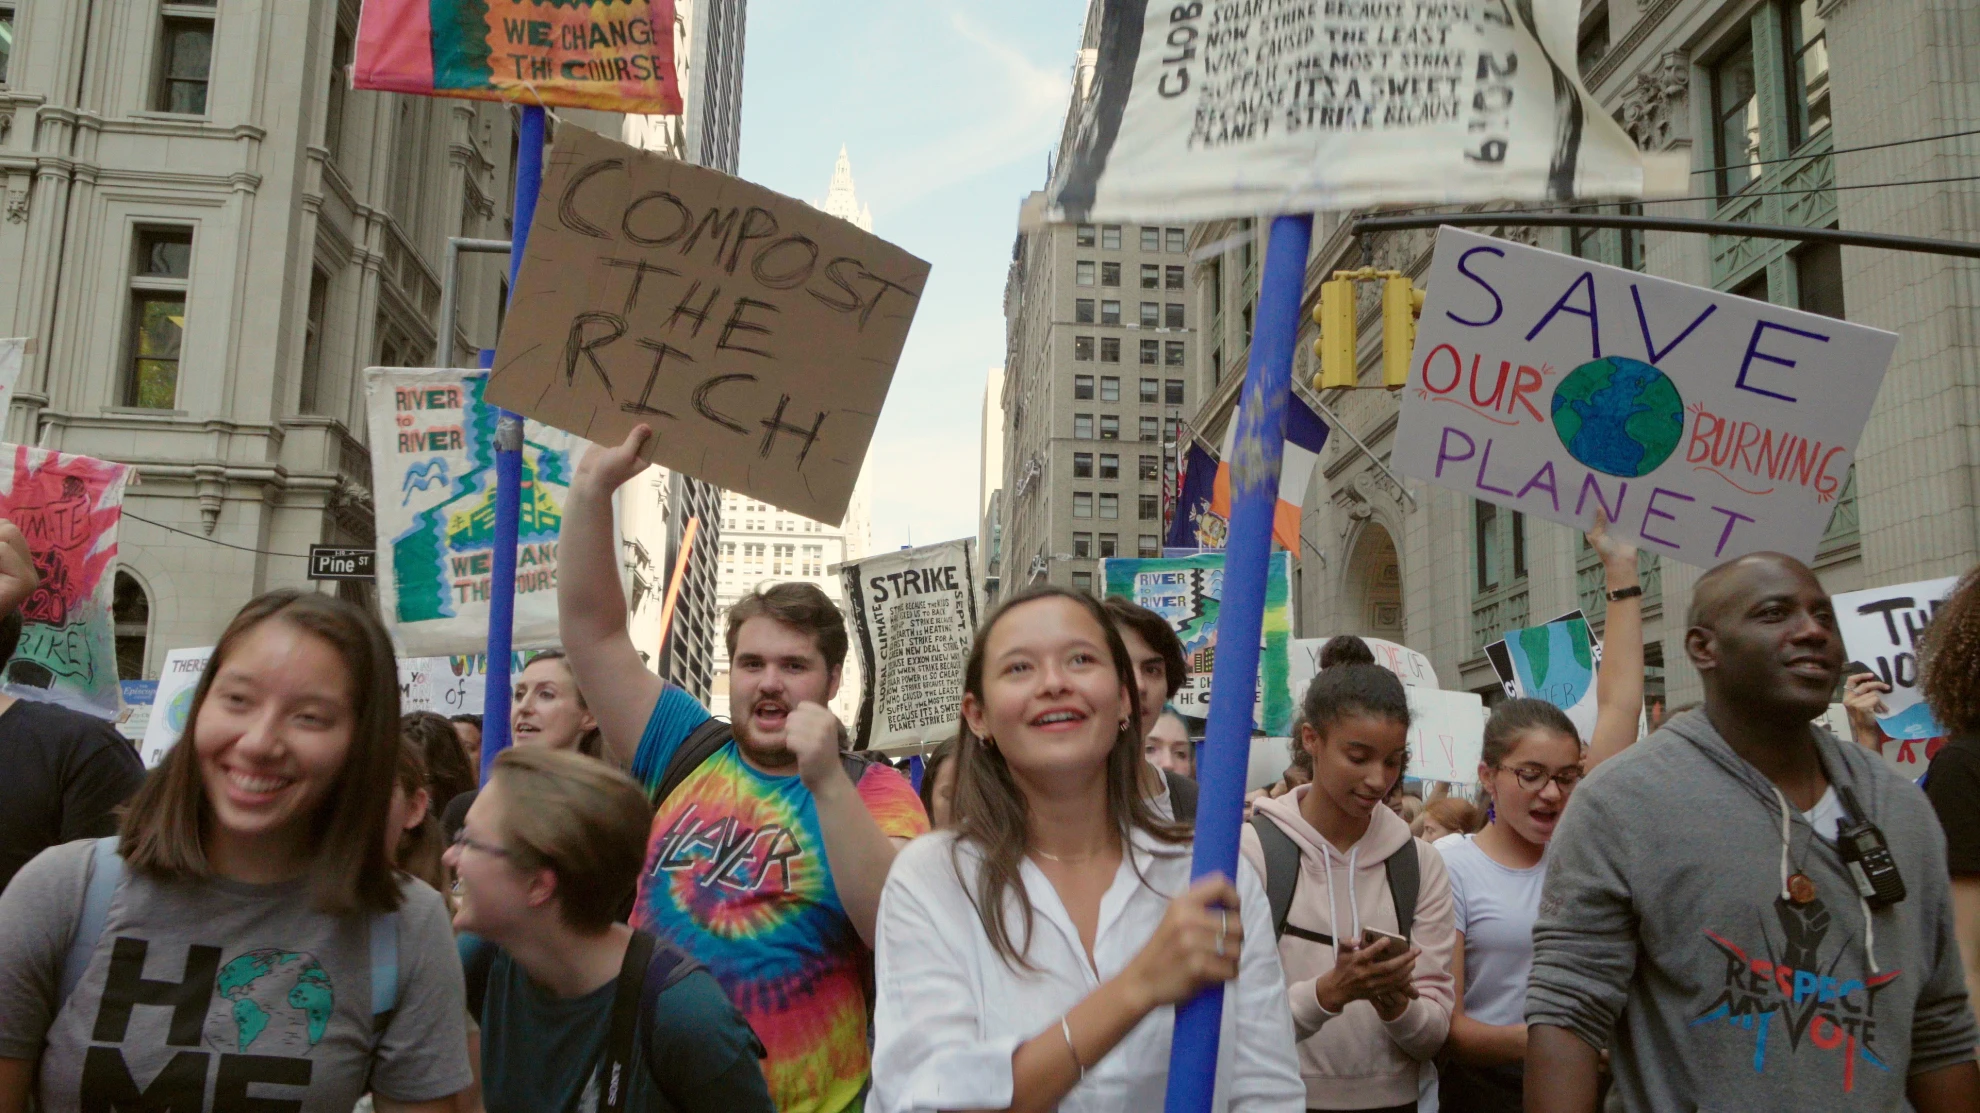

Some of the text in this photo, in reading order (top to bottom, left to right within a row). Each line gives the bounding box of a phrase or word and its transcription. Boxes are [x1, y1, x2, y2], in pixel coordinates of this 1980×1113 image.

[503, 18, 553, 48] WE
[1158, 0, 1203, 98] GLOB
[560, 54, 665, 82] COURSE
[557, 157, 921, 334] COMPOST
[597, 256, 783, 360] THE
[1446, 246, 1830, 403] SAVE
[396, 389, 460, 411] RIVER
[565, 310, 830, 472] RICH
[1422, 343, 1545, 423] OUR
[1686, 411, 1847, 497] BURNING
[398, 430, 464, 453] RIVER
[1434, 426, 1757, 559] PLANET
[319, 556, 369, 573] Pine ST
[451, 553, 491, 578] WE
[870, 566, 959, 604] STRIKE
[1140, 573, 1186, 586] RIVER
[954, 590, 966, 632] SEPT.
[1140, 596, 1186, 608] RIVER
[872, 603, 888, 660] CLIMATE
[910, 617, 935, 627] STRIKE
[20, 630, 81, 666] RIKE
[905, 645, 921, 656] NEW
[923, 643, 941, 654] DEAL
[908, 635, 933, 646] STRIKE
[934, 634, 947, 642] FOR
[949, 633, 954, 642] A
[897, 665, 916, 675] WHEN
[918, 662, 939, 673] STRIKE
[907, 654, 930, 666] EXXON
[930, 653, 949, 663] KNEW
[900, 682, 921, 693] STRIKE
[901, 673, 921, 685] POWER
[929, 671, 938, 680] SO
[939, 669, 960, 679] CHEAP
[886, 686, 959, 706] WHO CAUSED THE LEAST
[886, 694, 962, 715] SUFFER THE MOST STRIK
[887, 709, 919, 724] BECAUSE
[934, 705, 940, 715] A
[888, 719, 916, 733] PLANET
[919, 714, 945, 727] STRIKE
[651, 803, 804, 893] SLAYER
[1703, 929, 1902, 1017] RESPECT
